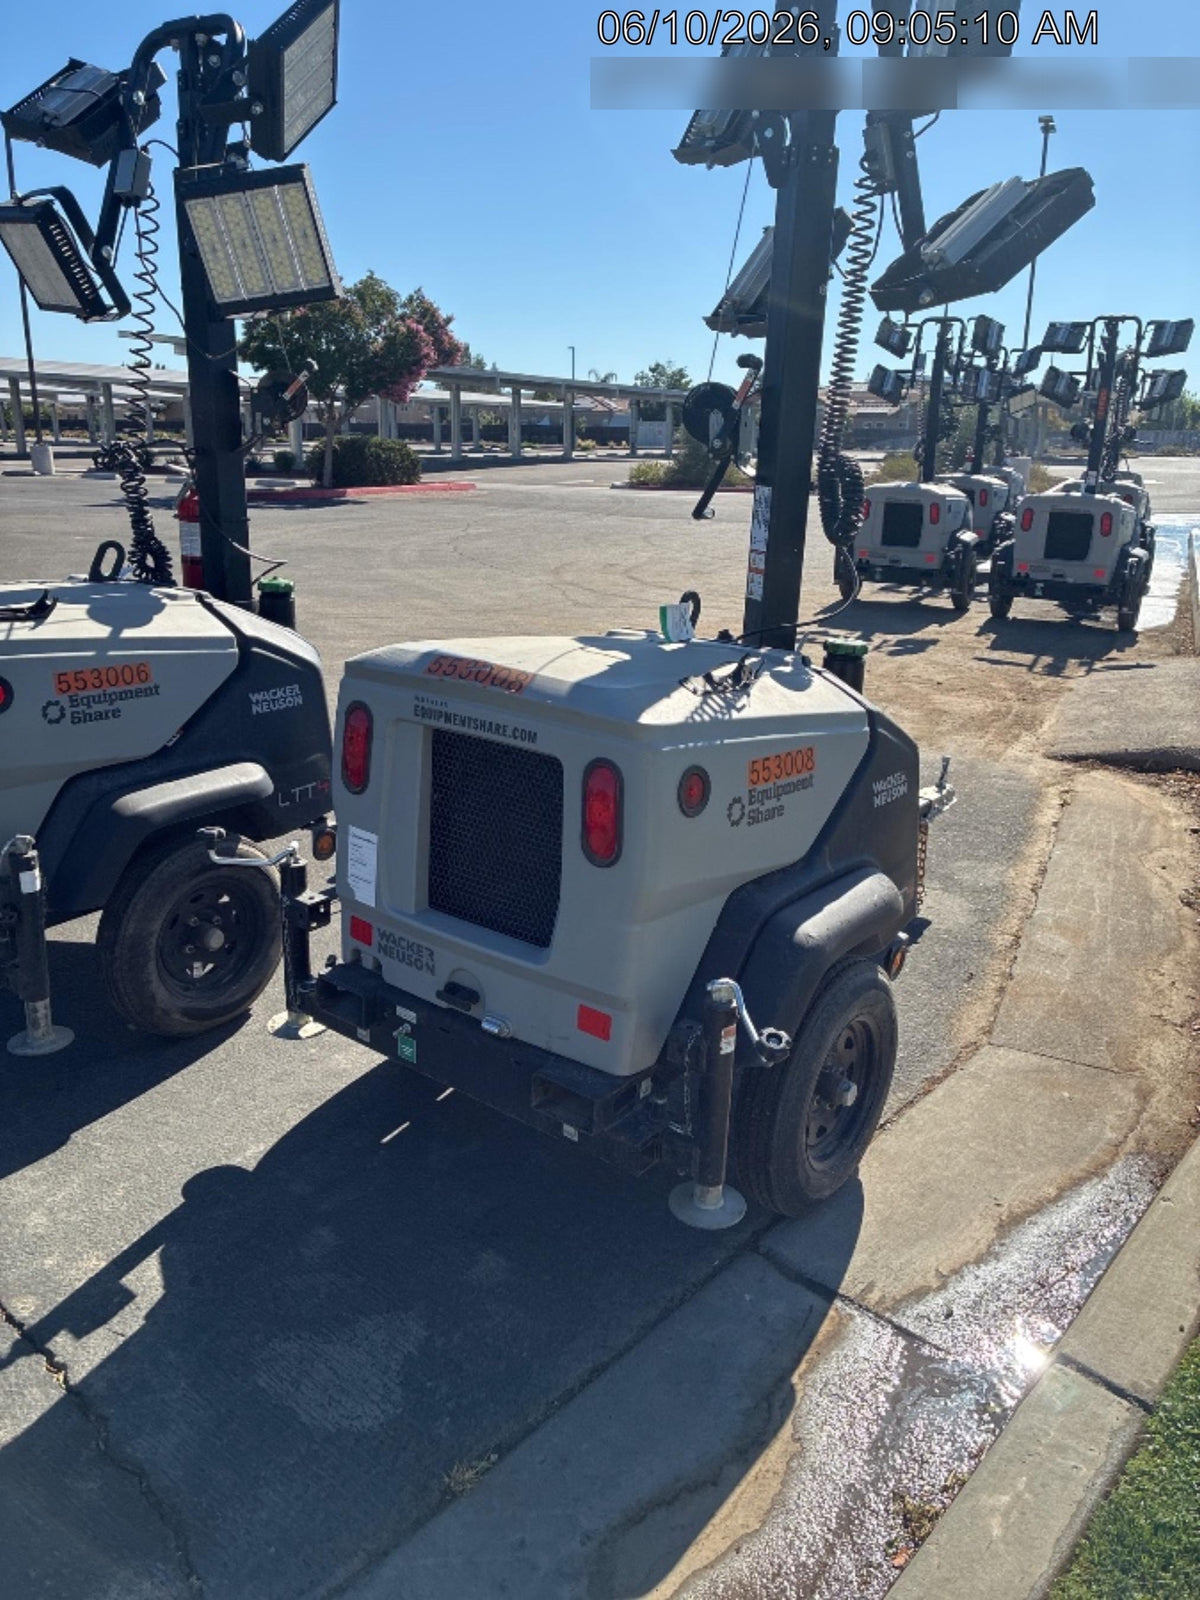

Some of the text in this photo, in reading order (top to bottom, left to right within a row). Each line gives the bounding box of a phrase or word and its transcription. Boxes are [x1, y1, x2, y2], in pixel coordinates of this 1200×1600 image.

[56, 662, 150, 695] 553006
[249, 684, 301, 704] WACKER
[68, 683, 161, 711] Equipment
[250, 694, 304, 716] NEUSON
[69, 706, 122, 726] Share
[413, 704, 539, 744] EQUIPMENTSHARE.COM
[750, 747, 816, 785] 553008
[748, 773, 815, 806] Equipment
[747, 804, 785, 826] Share
[377, 928, 435, 962] WACKER
[377, 942, 436, 977] NEUSON
